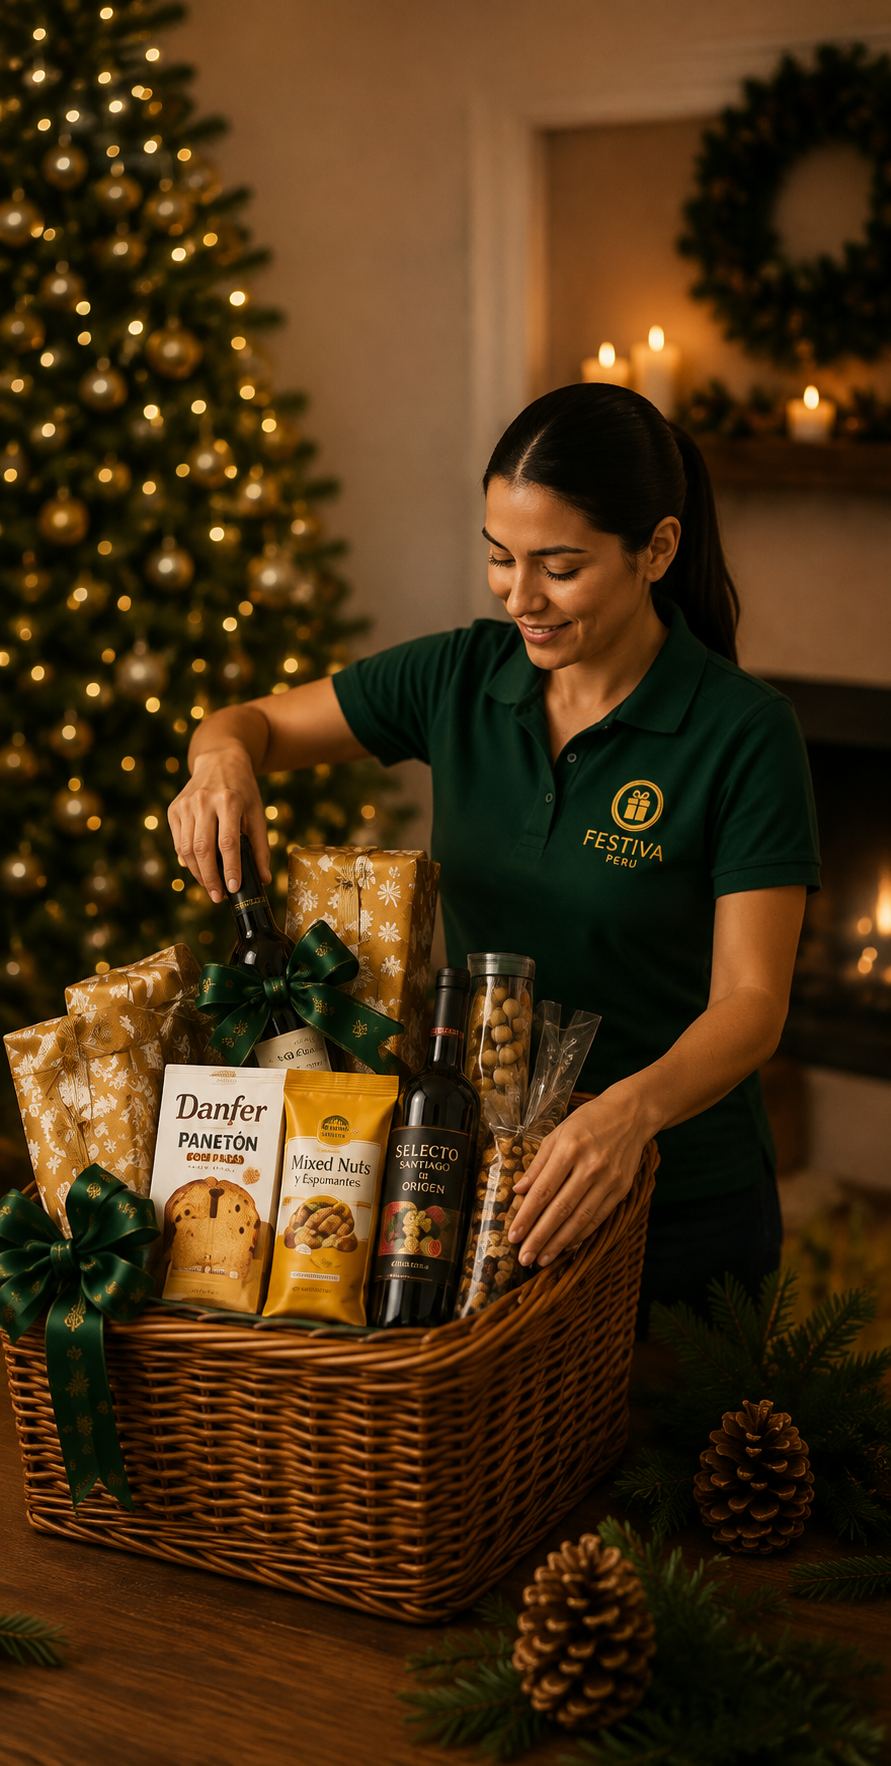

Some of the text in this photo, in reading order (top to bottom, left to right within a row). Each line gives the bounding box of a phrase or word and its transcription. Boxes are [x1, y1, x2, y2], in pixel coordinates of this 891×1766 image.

[583, 829, 663, 862] FESTIVA
[605, 854, 637, 869] PERU
[175, 1093, 268, 1126] Danfer
[178, 1131, 258, 1152] PANETÓN
[395, 1144, 459, 1162] SELECTO
[291, 1154, 372, 1176] Mixed Nuts
[399, 1160, 451, 1172] SANTIAGO
[401, 1181, 446, 1195] ORIGEN
